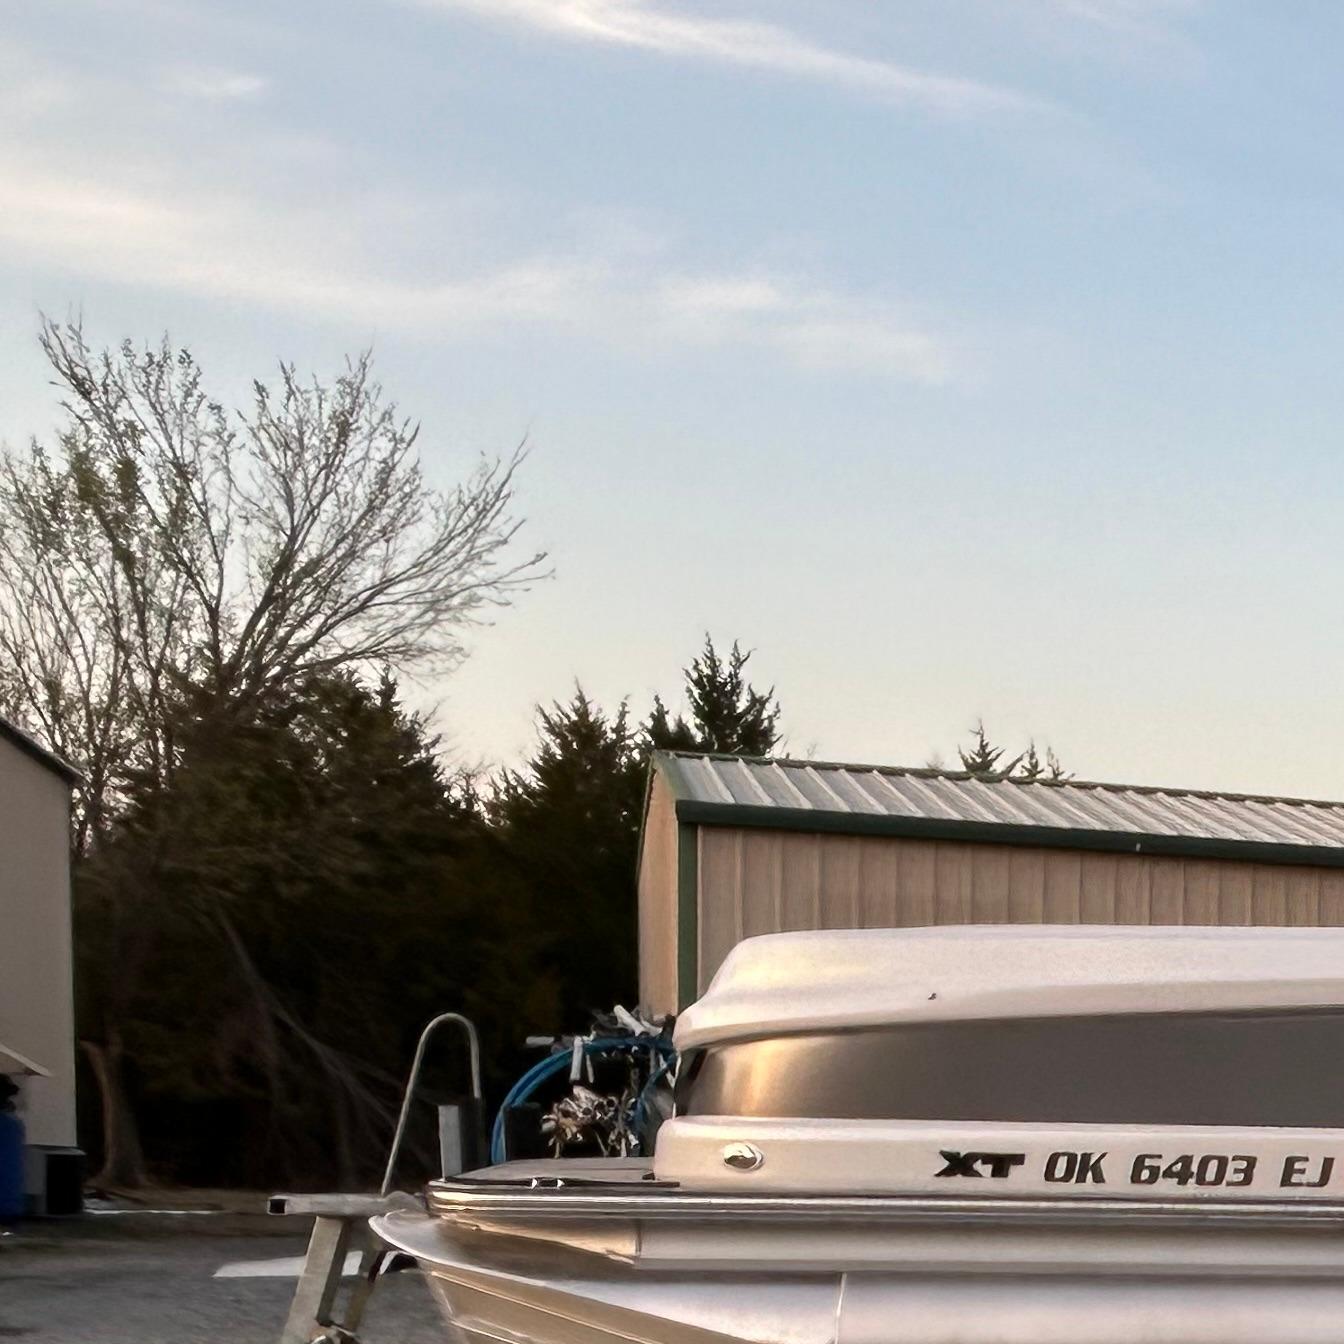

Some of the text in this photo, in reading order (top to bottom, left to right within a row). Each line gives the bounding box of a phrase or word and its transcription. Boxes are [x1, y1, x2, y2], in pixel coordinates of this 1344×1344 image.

[933, 1149, 1025, 1178] XT
[1044, 1151, 1108, 1184] OK
[1130, 1153, 1257, 1187] 6403
[1280, 1155, 1335, 1188] EJ
